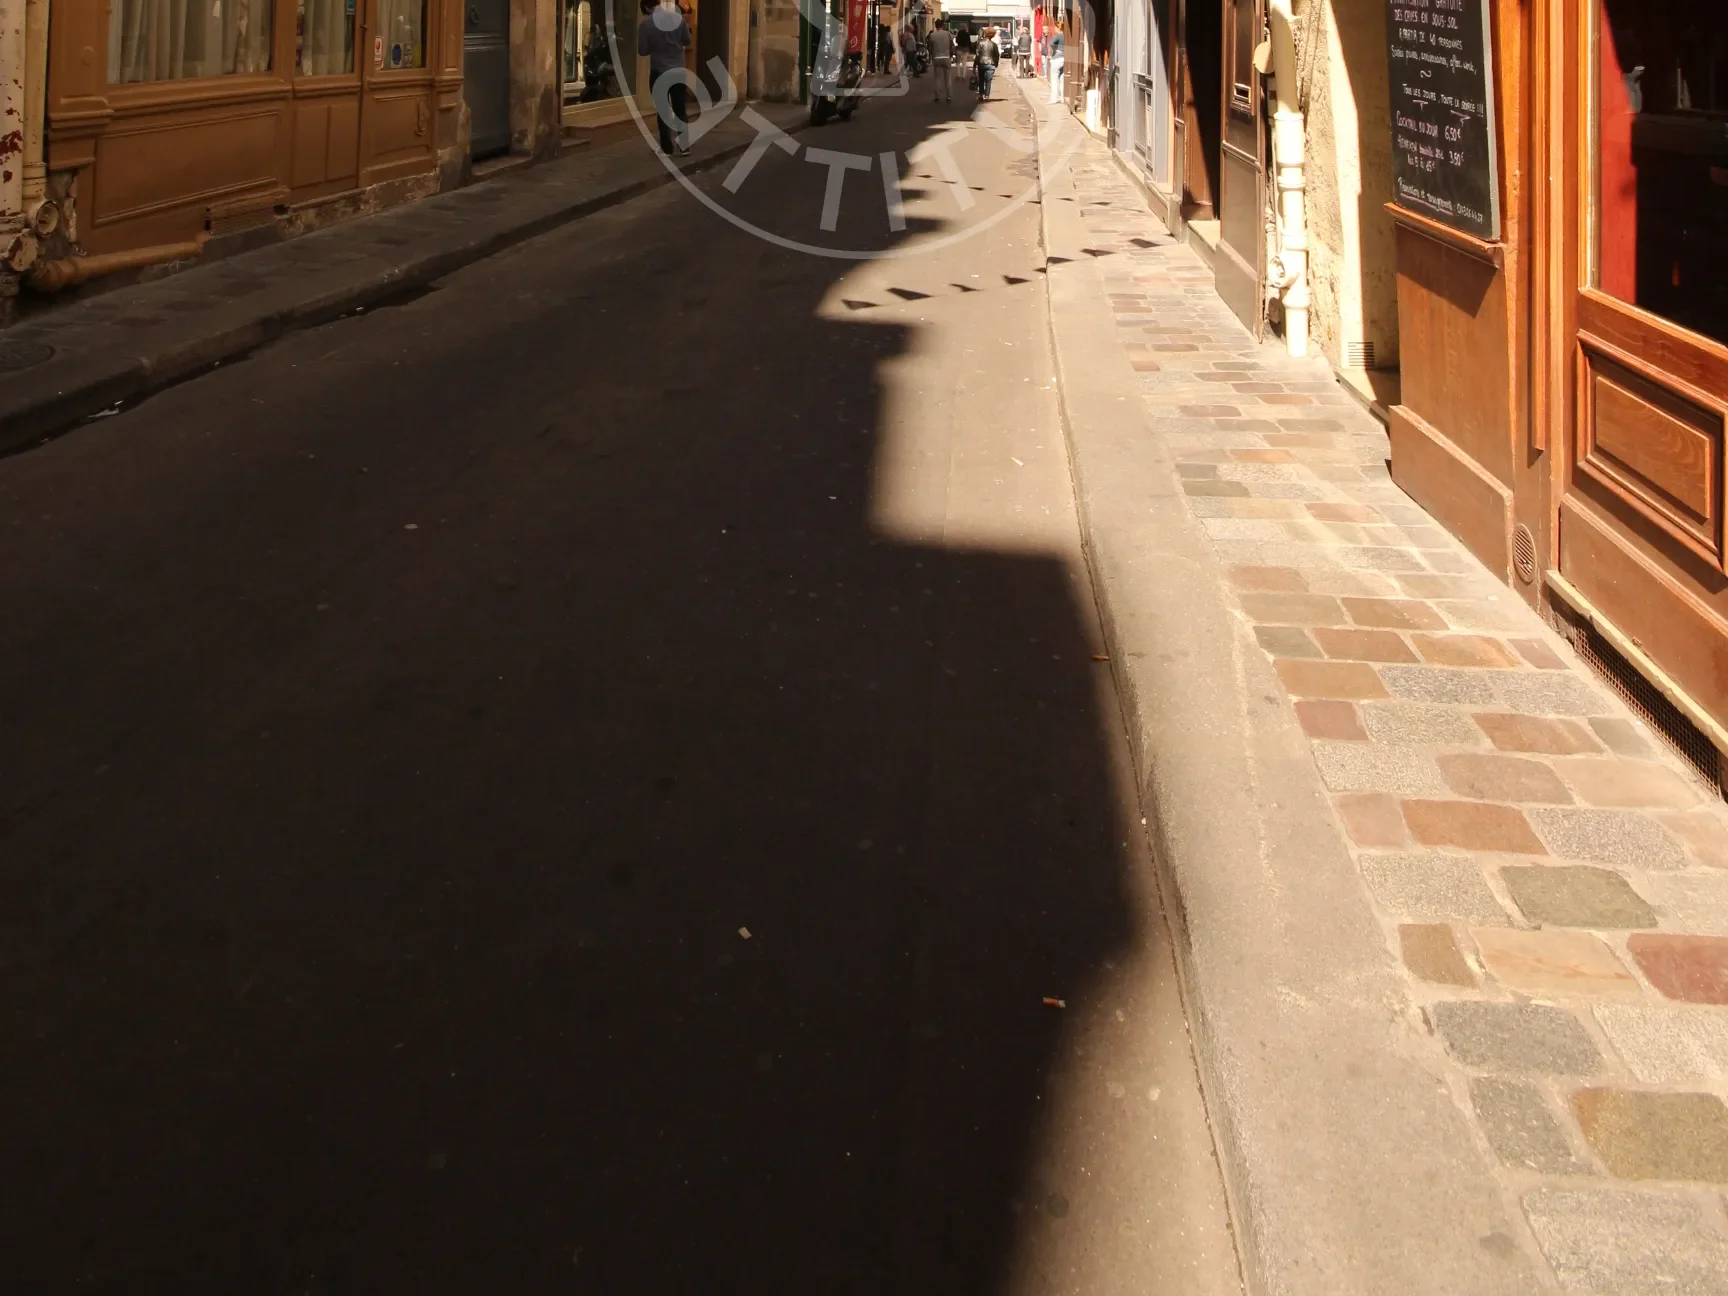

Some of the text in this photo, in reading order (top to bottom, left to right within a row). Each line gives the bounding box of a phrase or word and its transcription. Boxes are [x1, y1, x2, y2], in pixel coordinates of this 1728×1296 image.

[1394, 9, 1403, 21] DES
[1421, 11, 1428, 24] EN
[1419, 31, 1426, 43] DE
[1429, 32, 1436, 46] 40
[1438, 37, 1463, 50] PERSONNES
[1454, 97, 1459, 107] LA
[1426, 124, 1438, 138] JOUR
